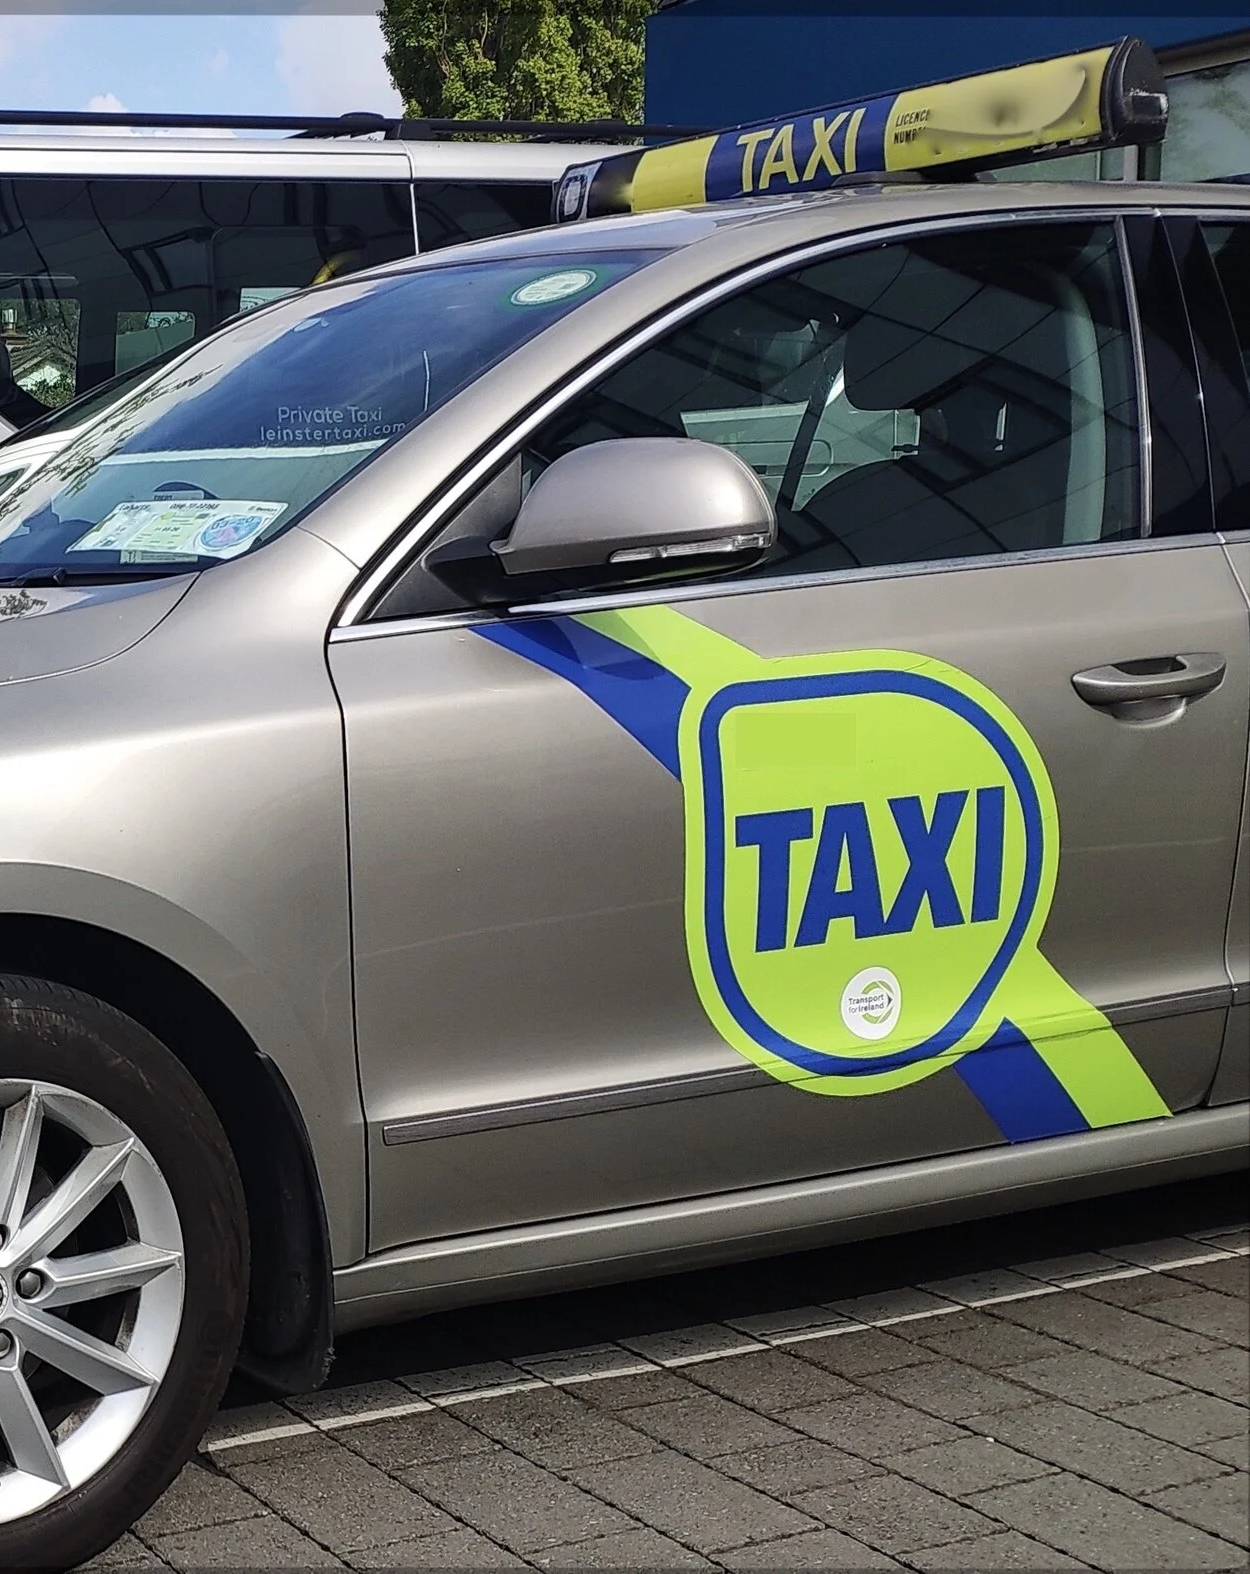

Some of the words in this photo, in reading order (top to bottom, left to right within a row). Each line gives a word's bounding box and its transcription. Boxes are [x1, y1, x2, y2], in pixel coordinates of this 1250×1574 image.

[736, 107, 867, 193] TAXI
[277, 405, 344, 424] Private
[347, 406, 383, 424] Taxi
[260, 421, 407, 441] leinstertaxi.com
[735, 785, 1006, 953] TAXI
[848, 994, 884, 1005] Transport
